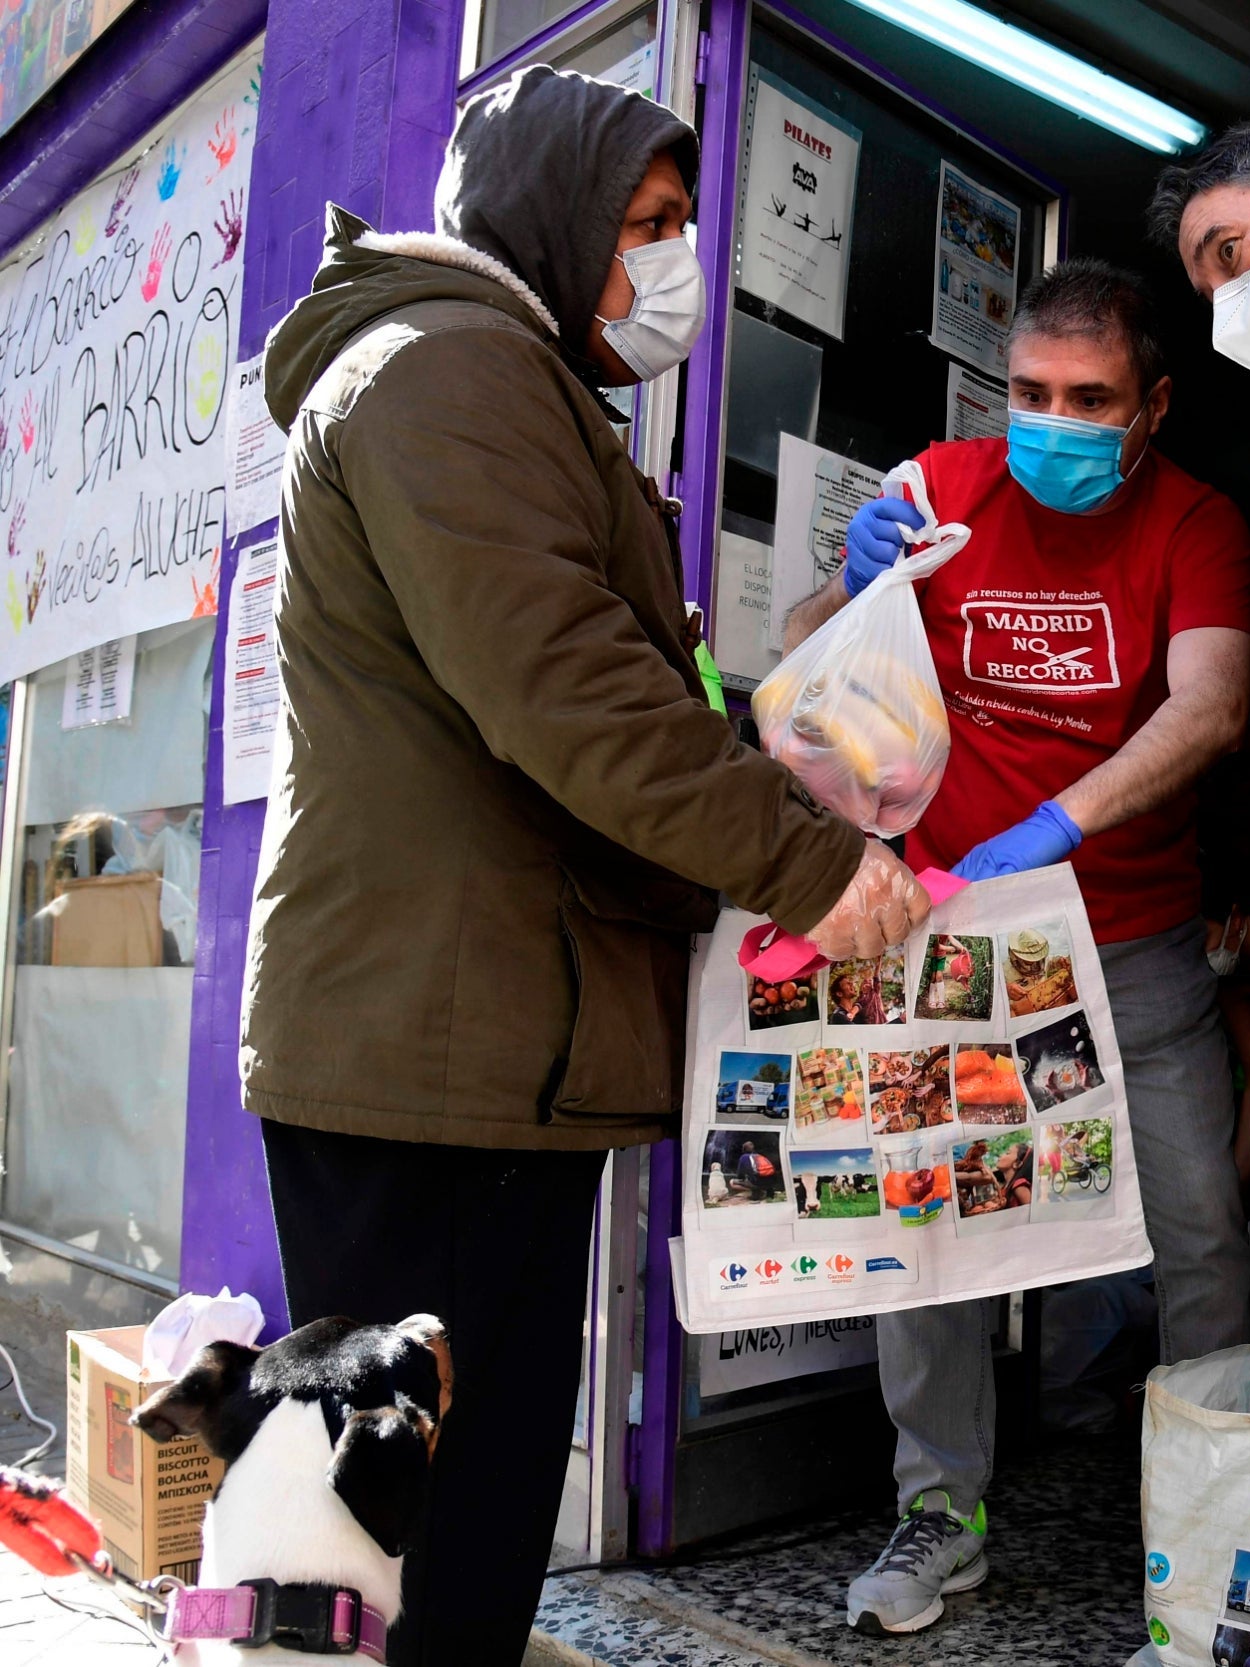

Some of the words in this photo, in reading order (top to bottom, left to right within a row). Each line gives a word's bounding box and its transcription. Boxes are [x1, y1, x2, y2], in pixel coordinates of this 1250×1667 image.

[784, 119, 832, 160] PILATES
[793, 167, 815, 190] AVA
[125, 485, 225, 588] ALUCHE
[744, 563, 753, 574] EL
[739, 595, 770, 612] REUNIO
[966, 589, 978, 599] sin
[980, 589, 1023, 599] recursos
[1025, 591, 1038, 600] no
[1040, 590, 1056, 602] hay
[985, 612, 1093, 633] MADRID
[1012, 636, 1050, 653] NO
[986, 661, 1095, 681] RECORTA
[157, 1444, 199, 1459] BISCUIT
[157, 1456, 210, 1473] BISCOTTO
[157, 1470, 209, 1487] BOLACHA
